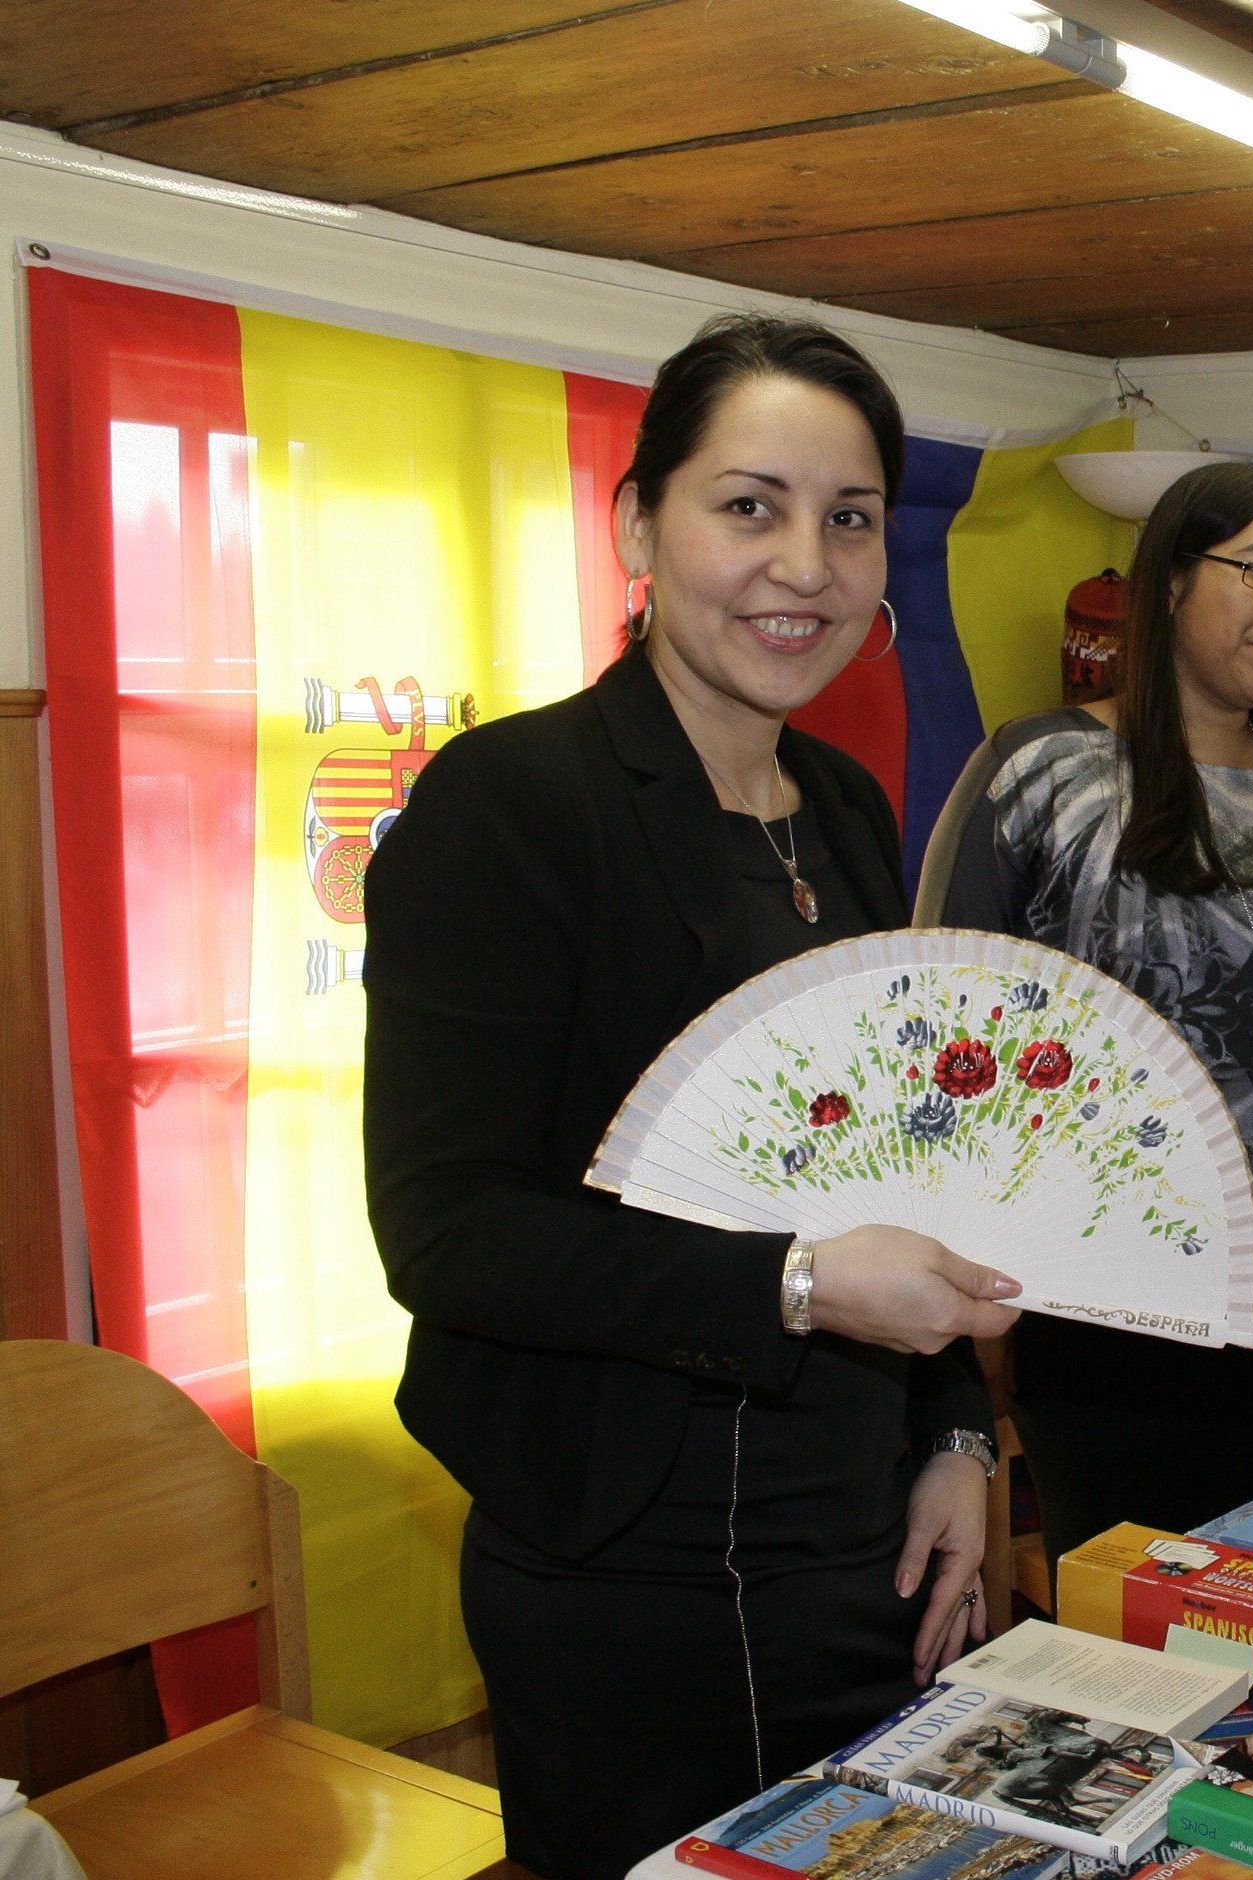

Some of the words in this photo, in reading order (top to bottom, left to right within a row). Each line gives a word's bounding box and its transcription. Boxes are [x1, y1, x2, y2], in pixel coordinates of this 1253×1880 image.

[864, 1690, 988, 1774] MADRID
[751, 1790, 869, 1858] MALLORCA
[894, 1785, 997, 1828] MADRID
[1180, 1816, 1217, 1841] PONS
[1149, 1850, 1202, 1880] VD-ROM
